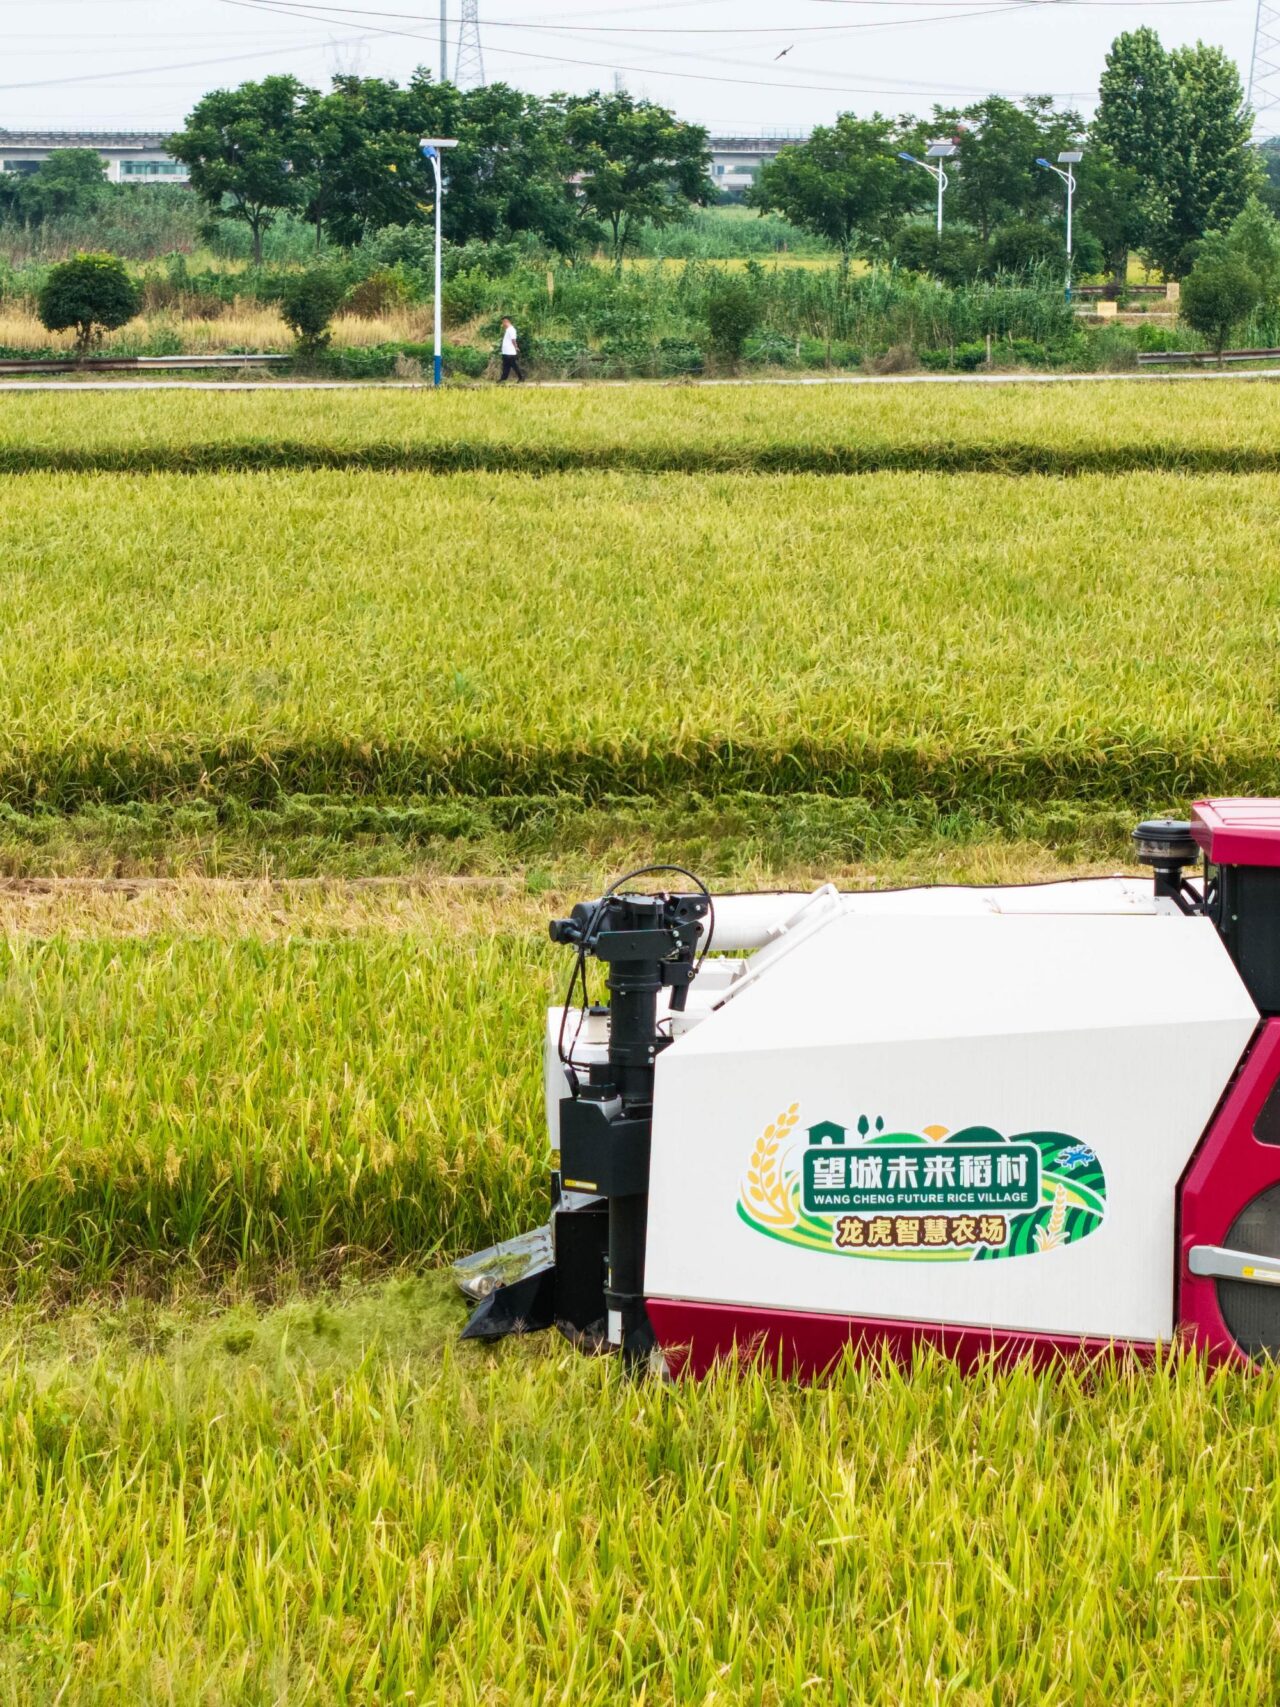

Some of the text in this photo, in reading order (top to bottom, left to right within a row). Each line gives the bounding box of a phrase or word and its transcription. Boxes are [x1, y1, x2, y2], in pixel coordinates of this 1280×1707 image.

[812, 1154, 1029, 1189] 望城未来稻村
[814, 1192, 1028, 1205] WANG CHENG FUTURE RICE VILLAGE
[839, 1217, 1006, 1245] 龙虎智慧农场
